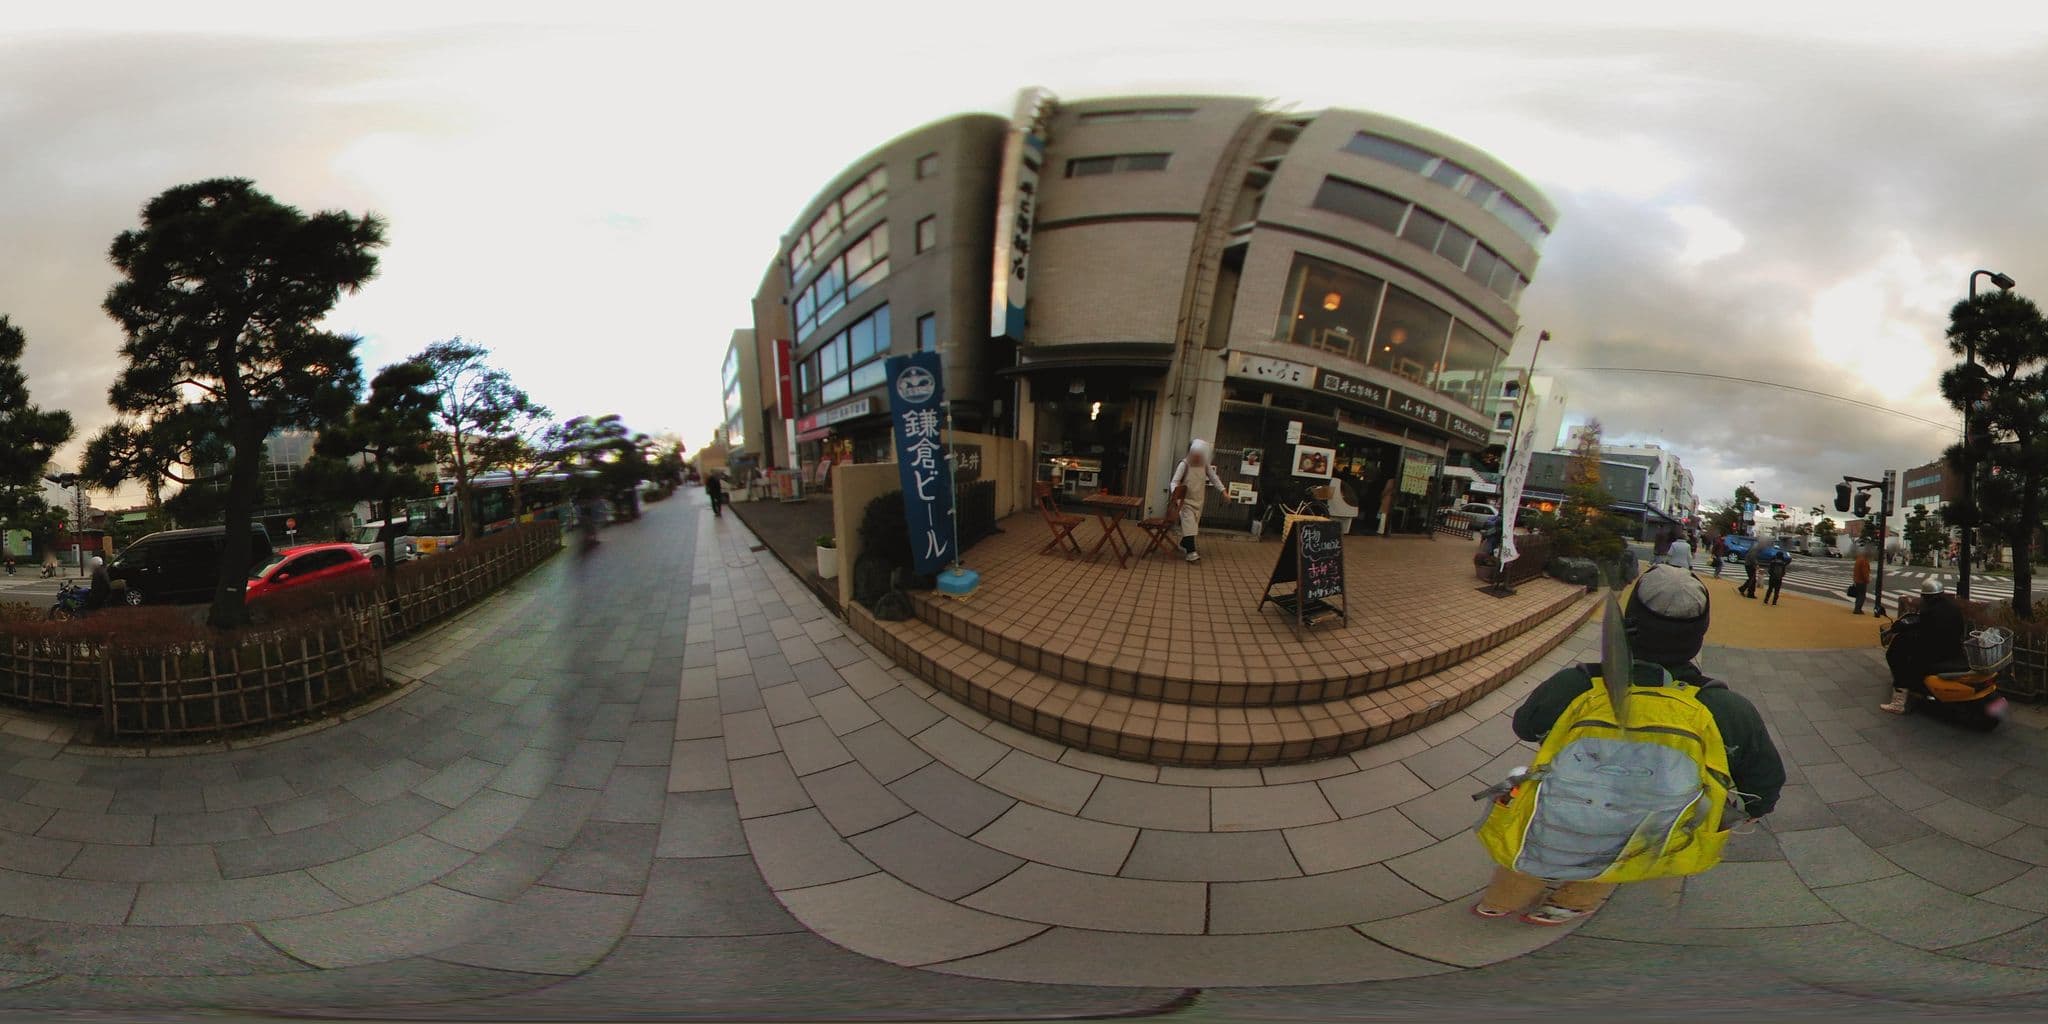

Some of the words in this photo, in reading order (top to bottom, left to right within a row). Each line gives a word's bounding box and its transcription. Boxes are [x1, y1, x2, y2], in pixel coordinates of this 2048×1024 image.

[902, 408, 948, 560] 鎌倉ビール
